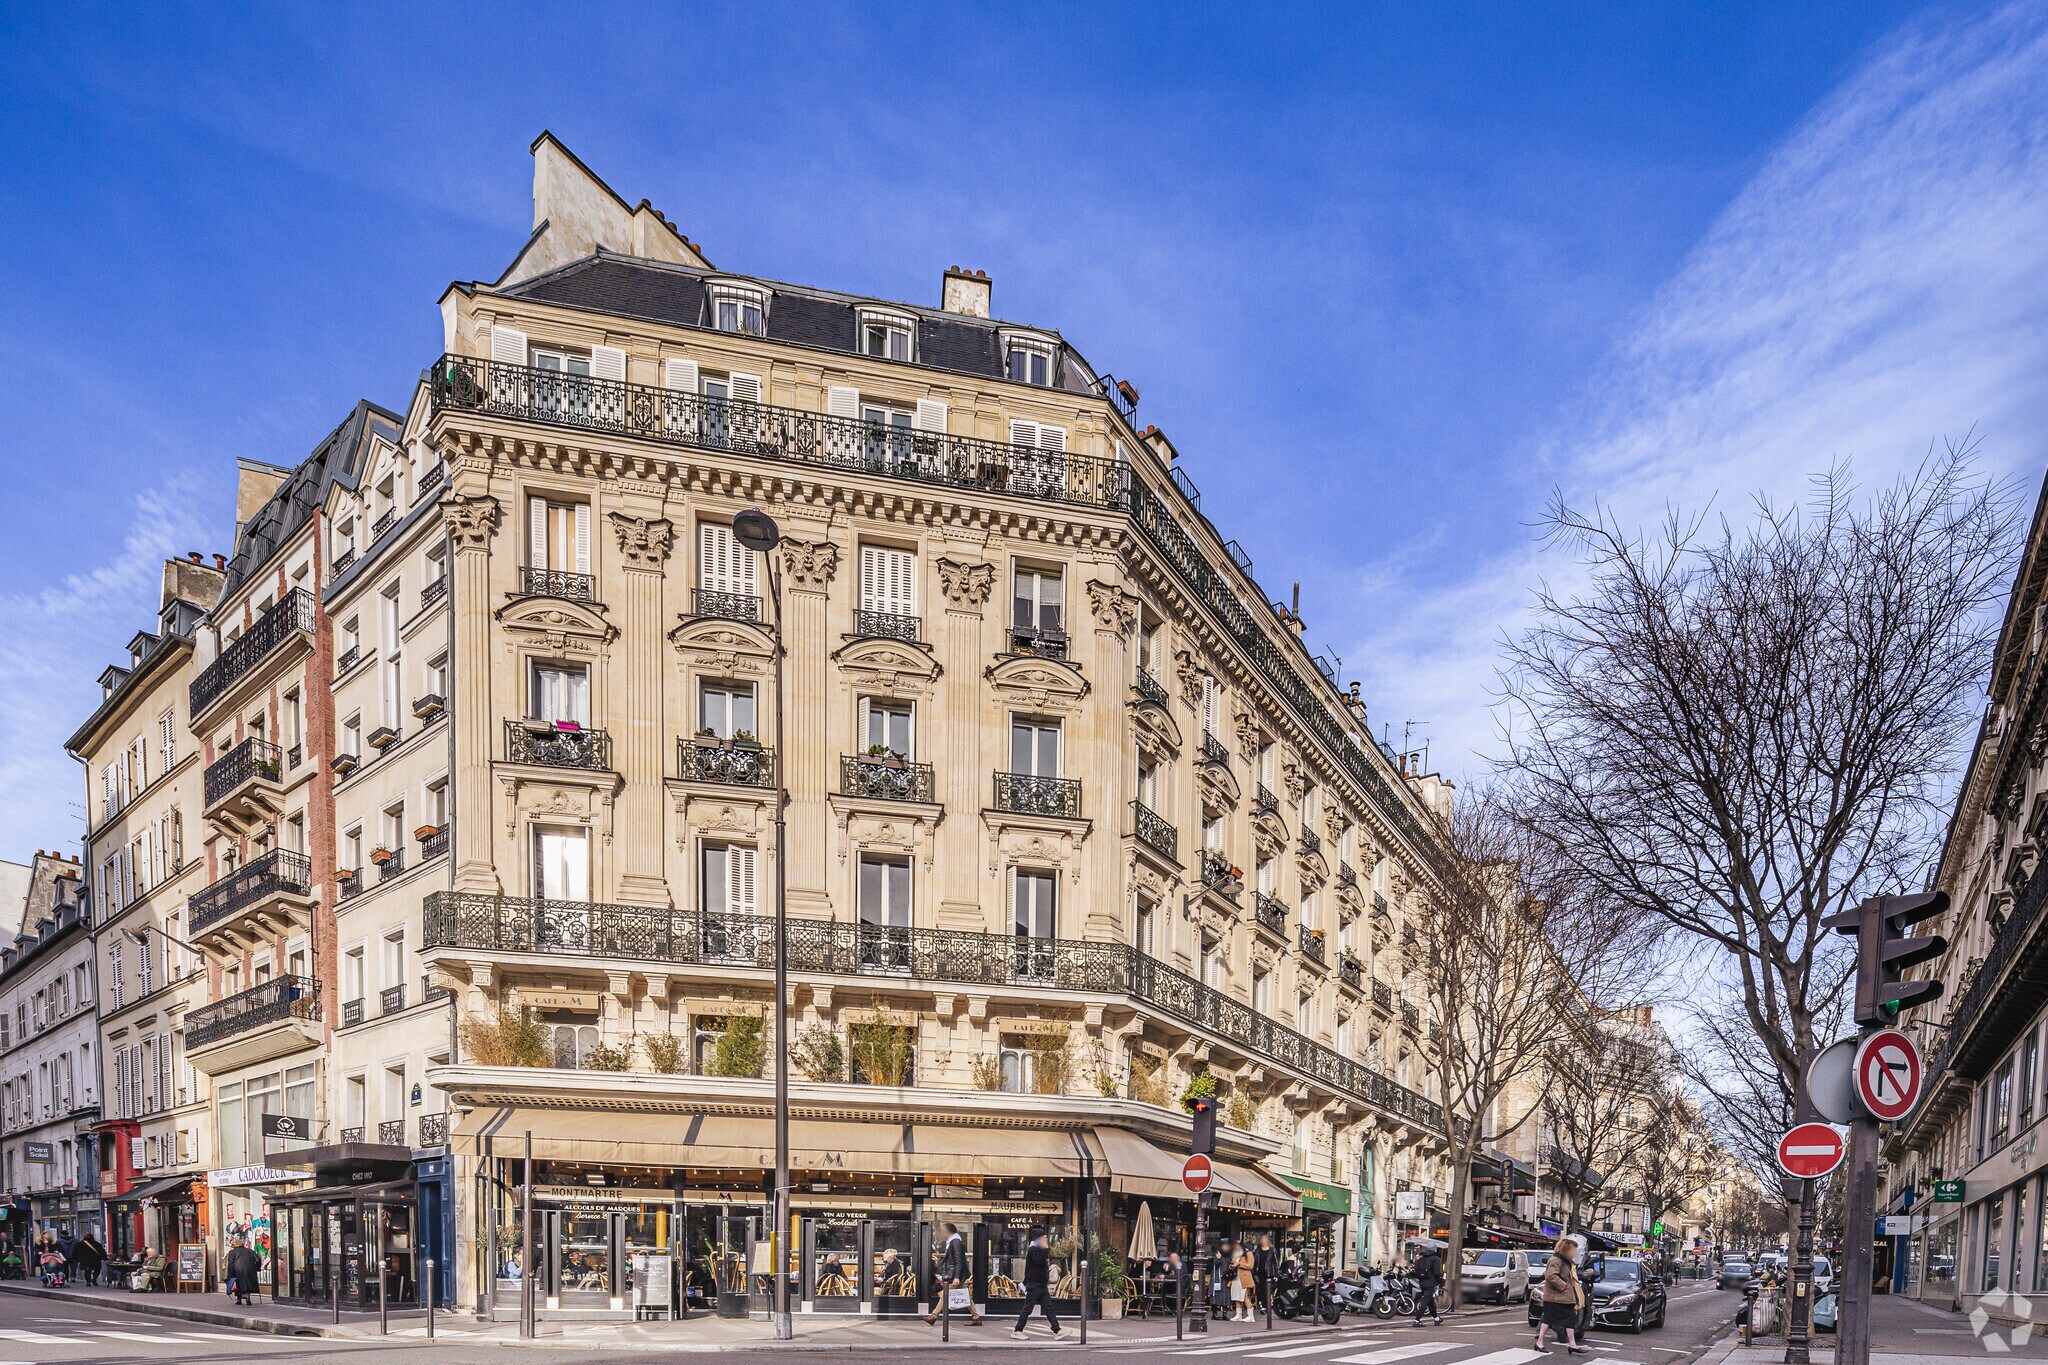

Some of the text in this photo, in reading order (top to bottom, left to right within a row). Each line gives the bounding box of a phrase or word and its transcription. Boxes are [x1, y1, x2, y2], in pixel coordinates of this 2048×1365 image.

[570, 996, 583, 1006] M
[758, 1152, 844, 1168] CE M
[352, 1173, 363, 1181] CHEZ
[1503, 1161, 1511, 1200] PIZZA
[551, 1188, 623, 1199] MONTMARTRE
[717, 1192, 733, 1202] M
[991, 1202, 1041, 1211] MAUBEUGE
[1253, 1197, 1261, 1210] M
[574, 1212, 601, 1220] Service
[828, 1218, 858, 1226] Cocktails
